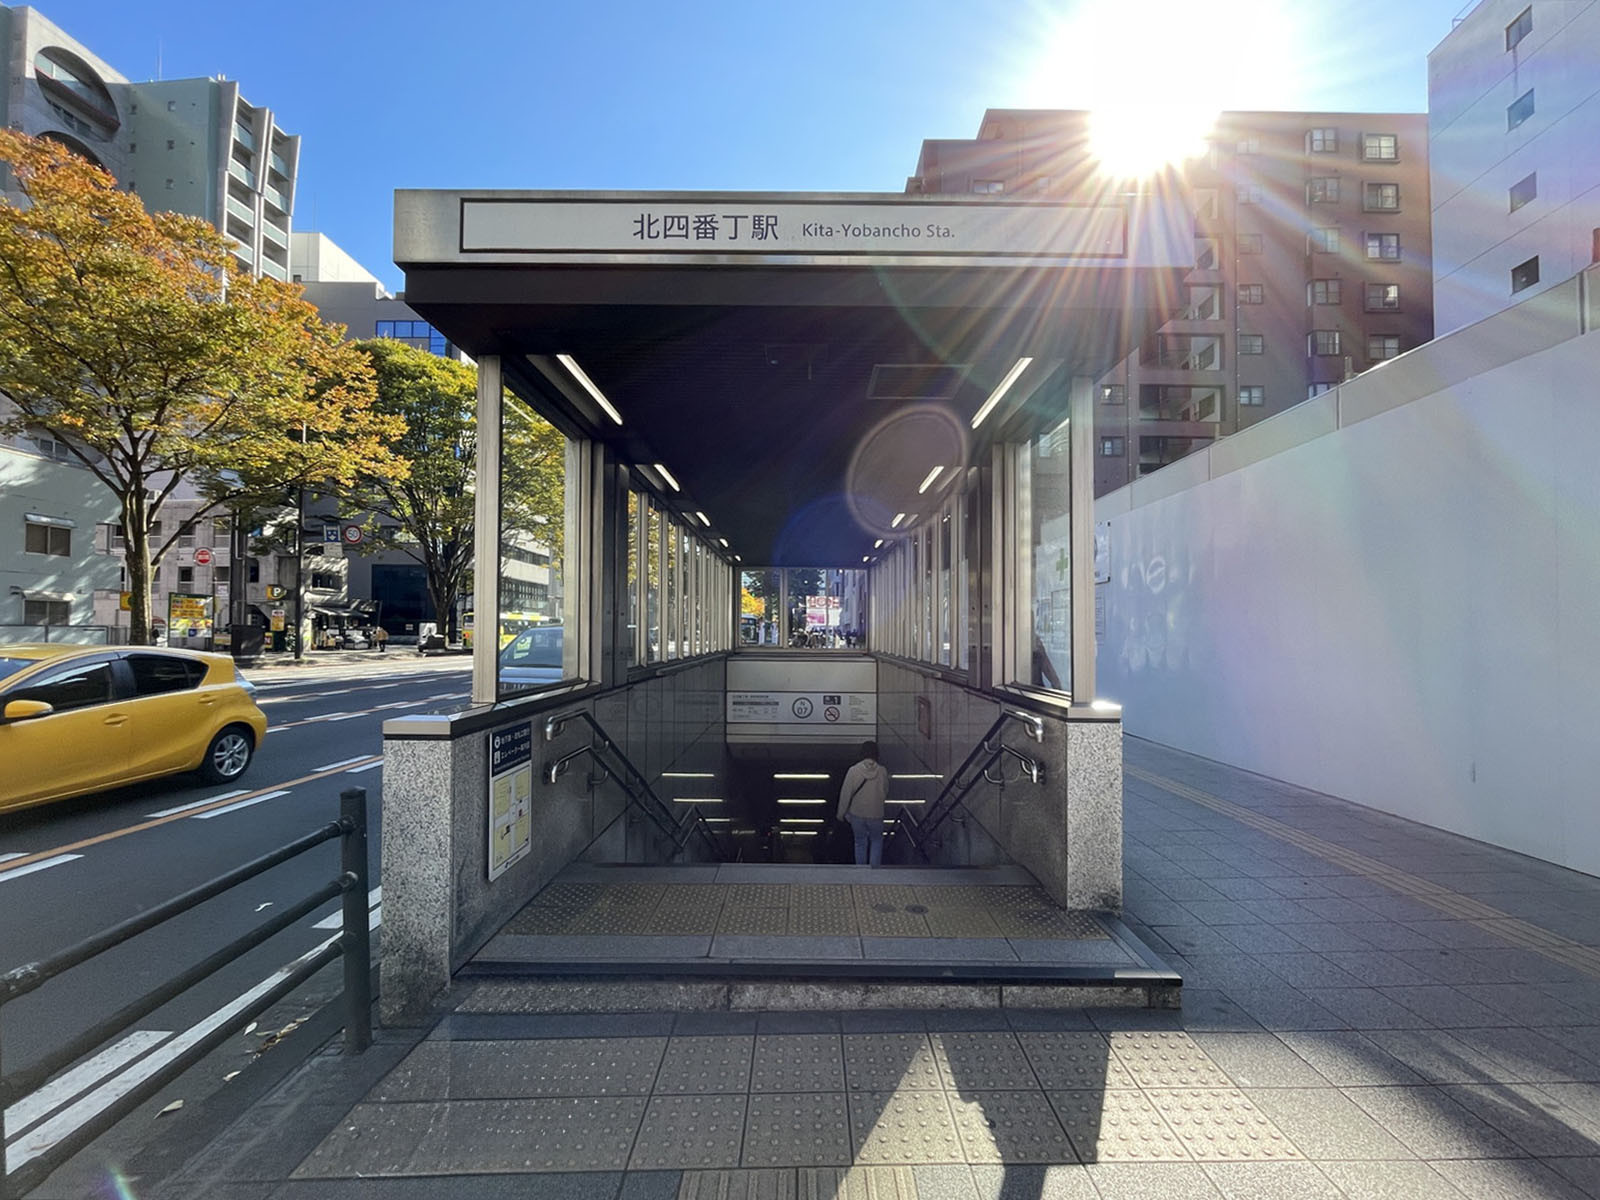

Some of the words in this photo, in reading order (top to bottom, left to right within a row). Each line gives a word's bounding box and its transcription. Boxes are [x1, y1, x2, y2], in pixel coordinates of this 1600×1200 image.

[633, 213, 779, 241] 北四番丁駅
[802, 223, 921, 238] Kita-Yobancho
[926, 224, 955, 238] Sta.
[273, 587, 281, 597] P
[797, 707, 808, 715] 07
